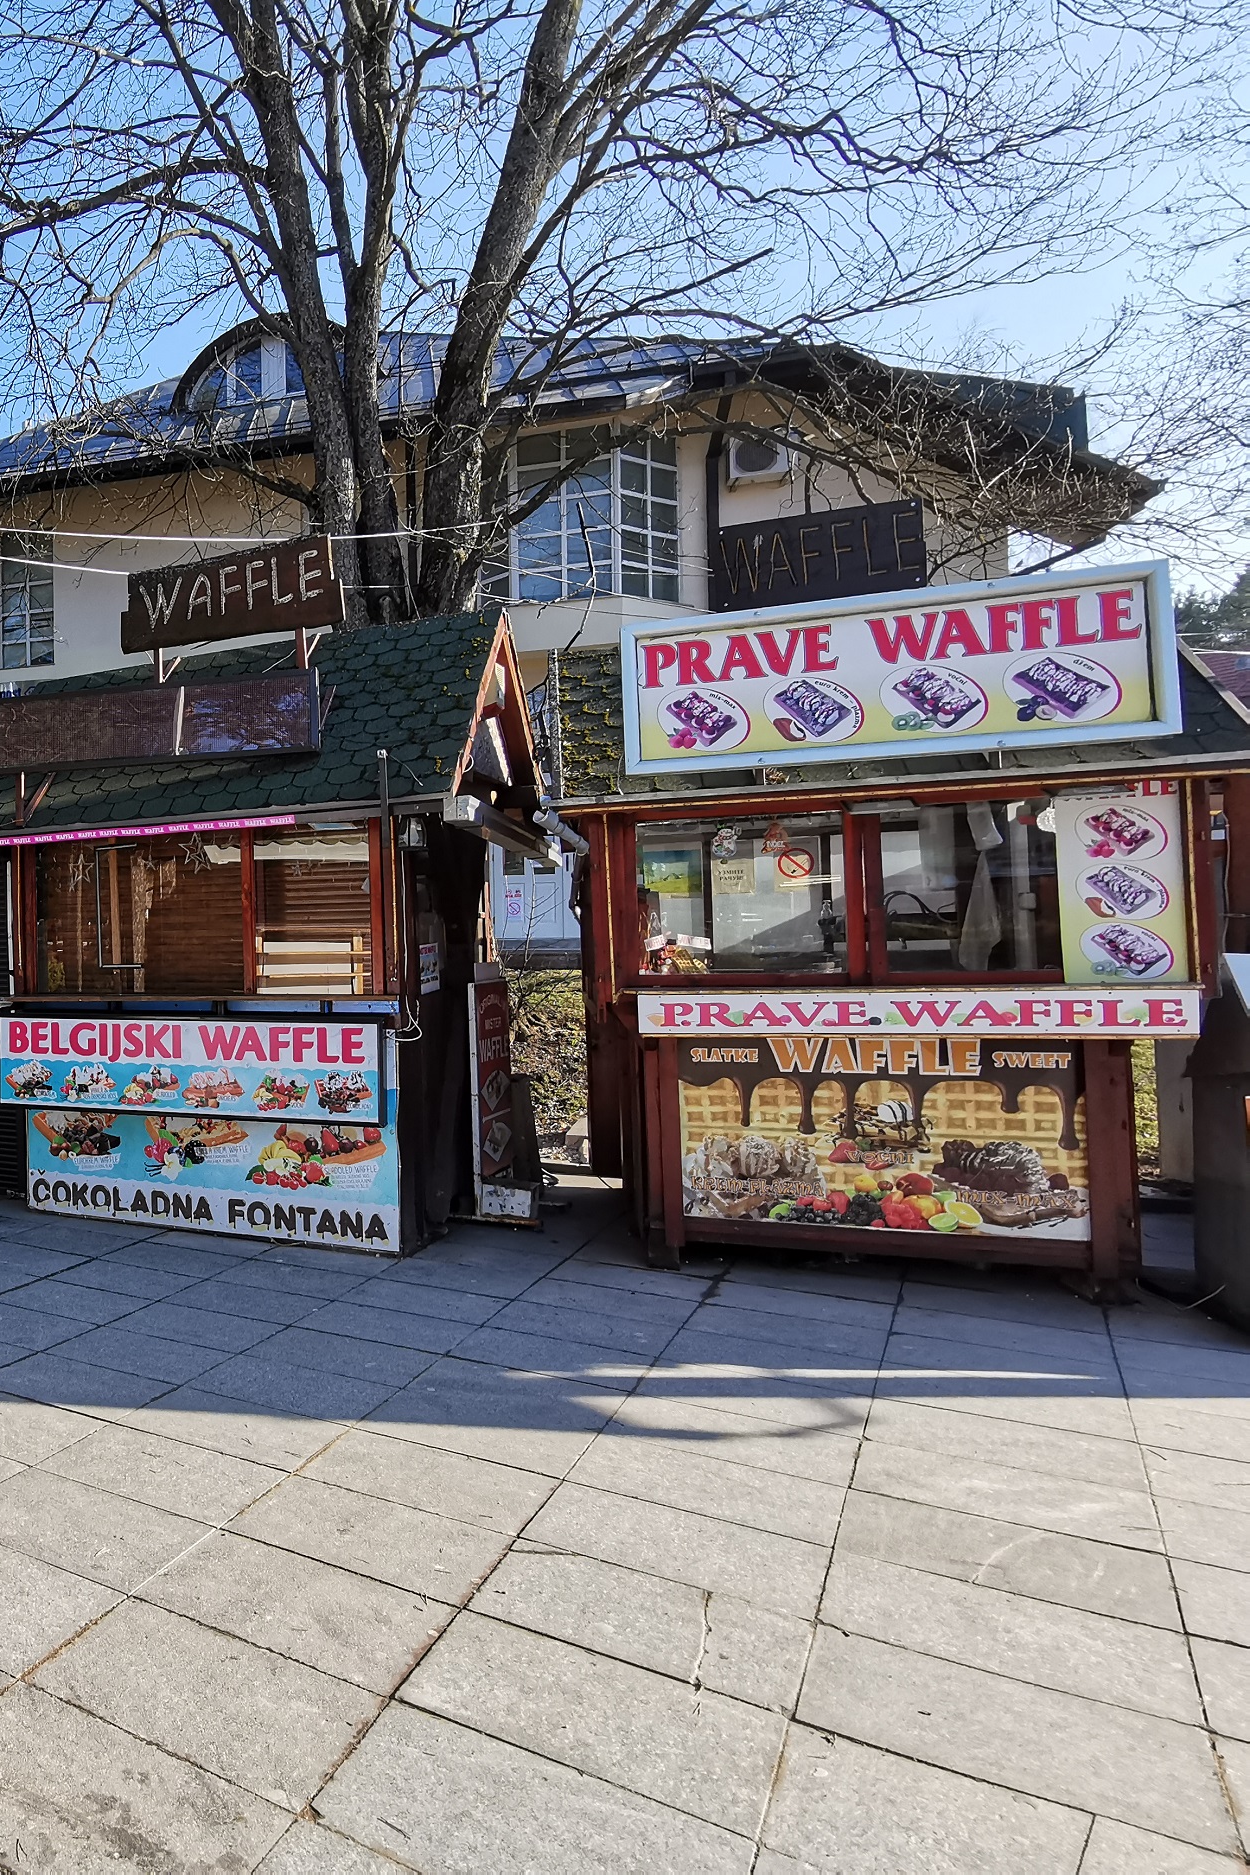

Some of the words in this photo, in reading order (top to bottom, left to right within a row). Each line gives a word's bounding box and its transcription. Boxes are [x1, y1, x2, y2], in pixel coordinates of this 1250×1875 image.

[720, 511, 920, 595] WAFFLE
[139, 549, 324, 630] WAFFLE
[642, 624, 839, 690] PRAVE
[865, 588, 1143, 664] WAFFLE
[709, 692, 736, 709] mix-max
[168, 824, 189, 832] WAFFLE
[218, 821, 240, 829] WAFFLE
[270, 816, 294, 824] WAFFLE
[659, 1000, 867, 1028] PRAVE
[891, 999, 1189, 1028] WAFFLE
[8, 1021, 182, 1062] BELGIJSKI
[200, 1025, 365, 1064] WAFFLE
[478, 1034, 509, 1064] WAFFLE
[690, 1047, 759, 1064] SLATKE
[766, 1037, 983, 1077] WAFFLE
[992, 1051, 1071, 1069] SWEET
[31, 1168, 213, 1221] ČOKOLADNA
[228, 1198, 390, 1243] FONTANA
